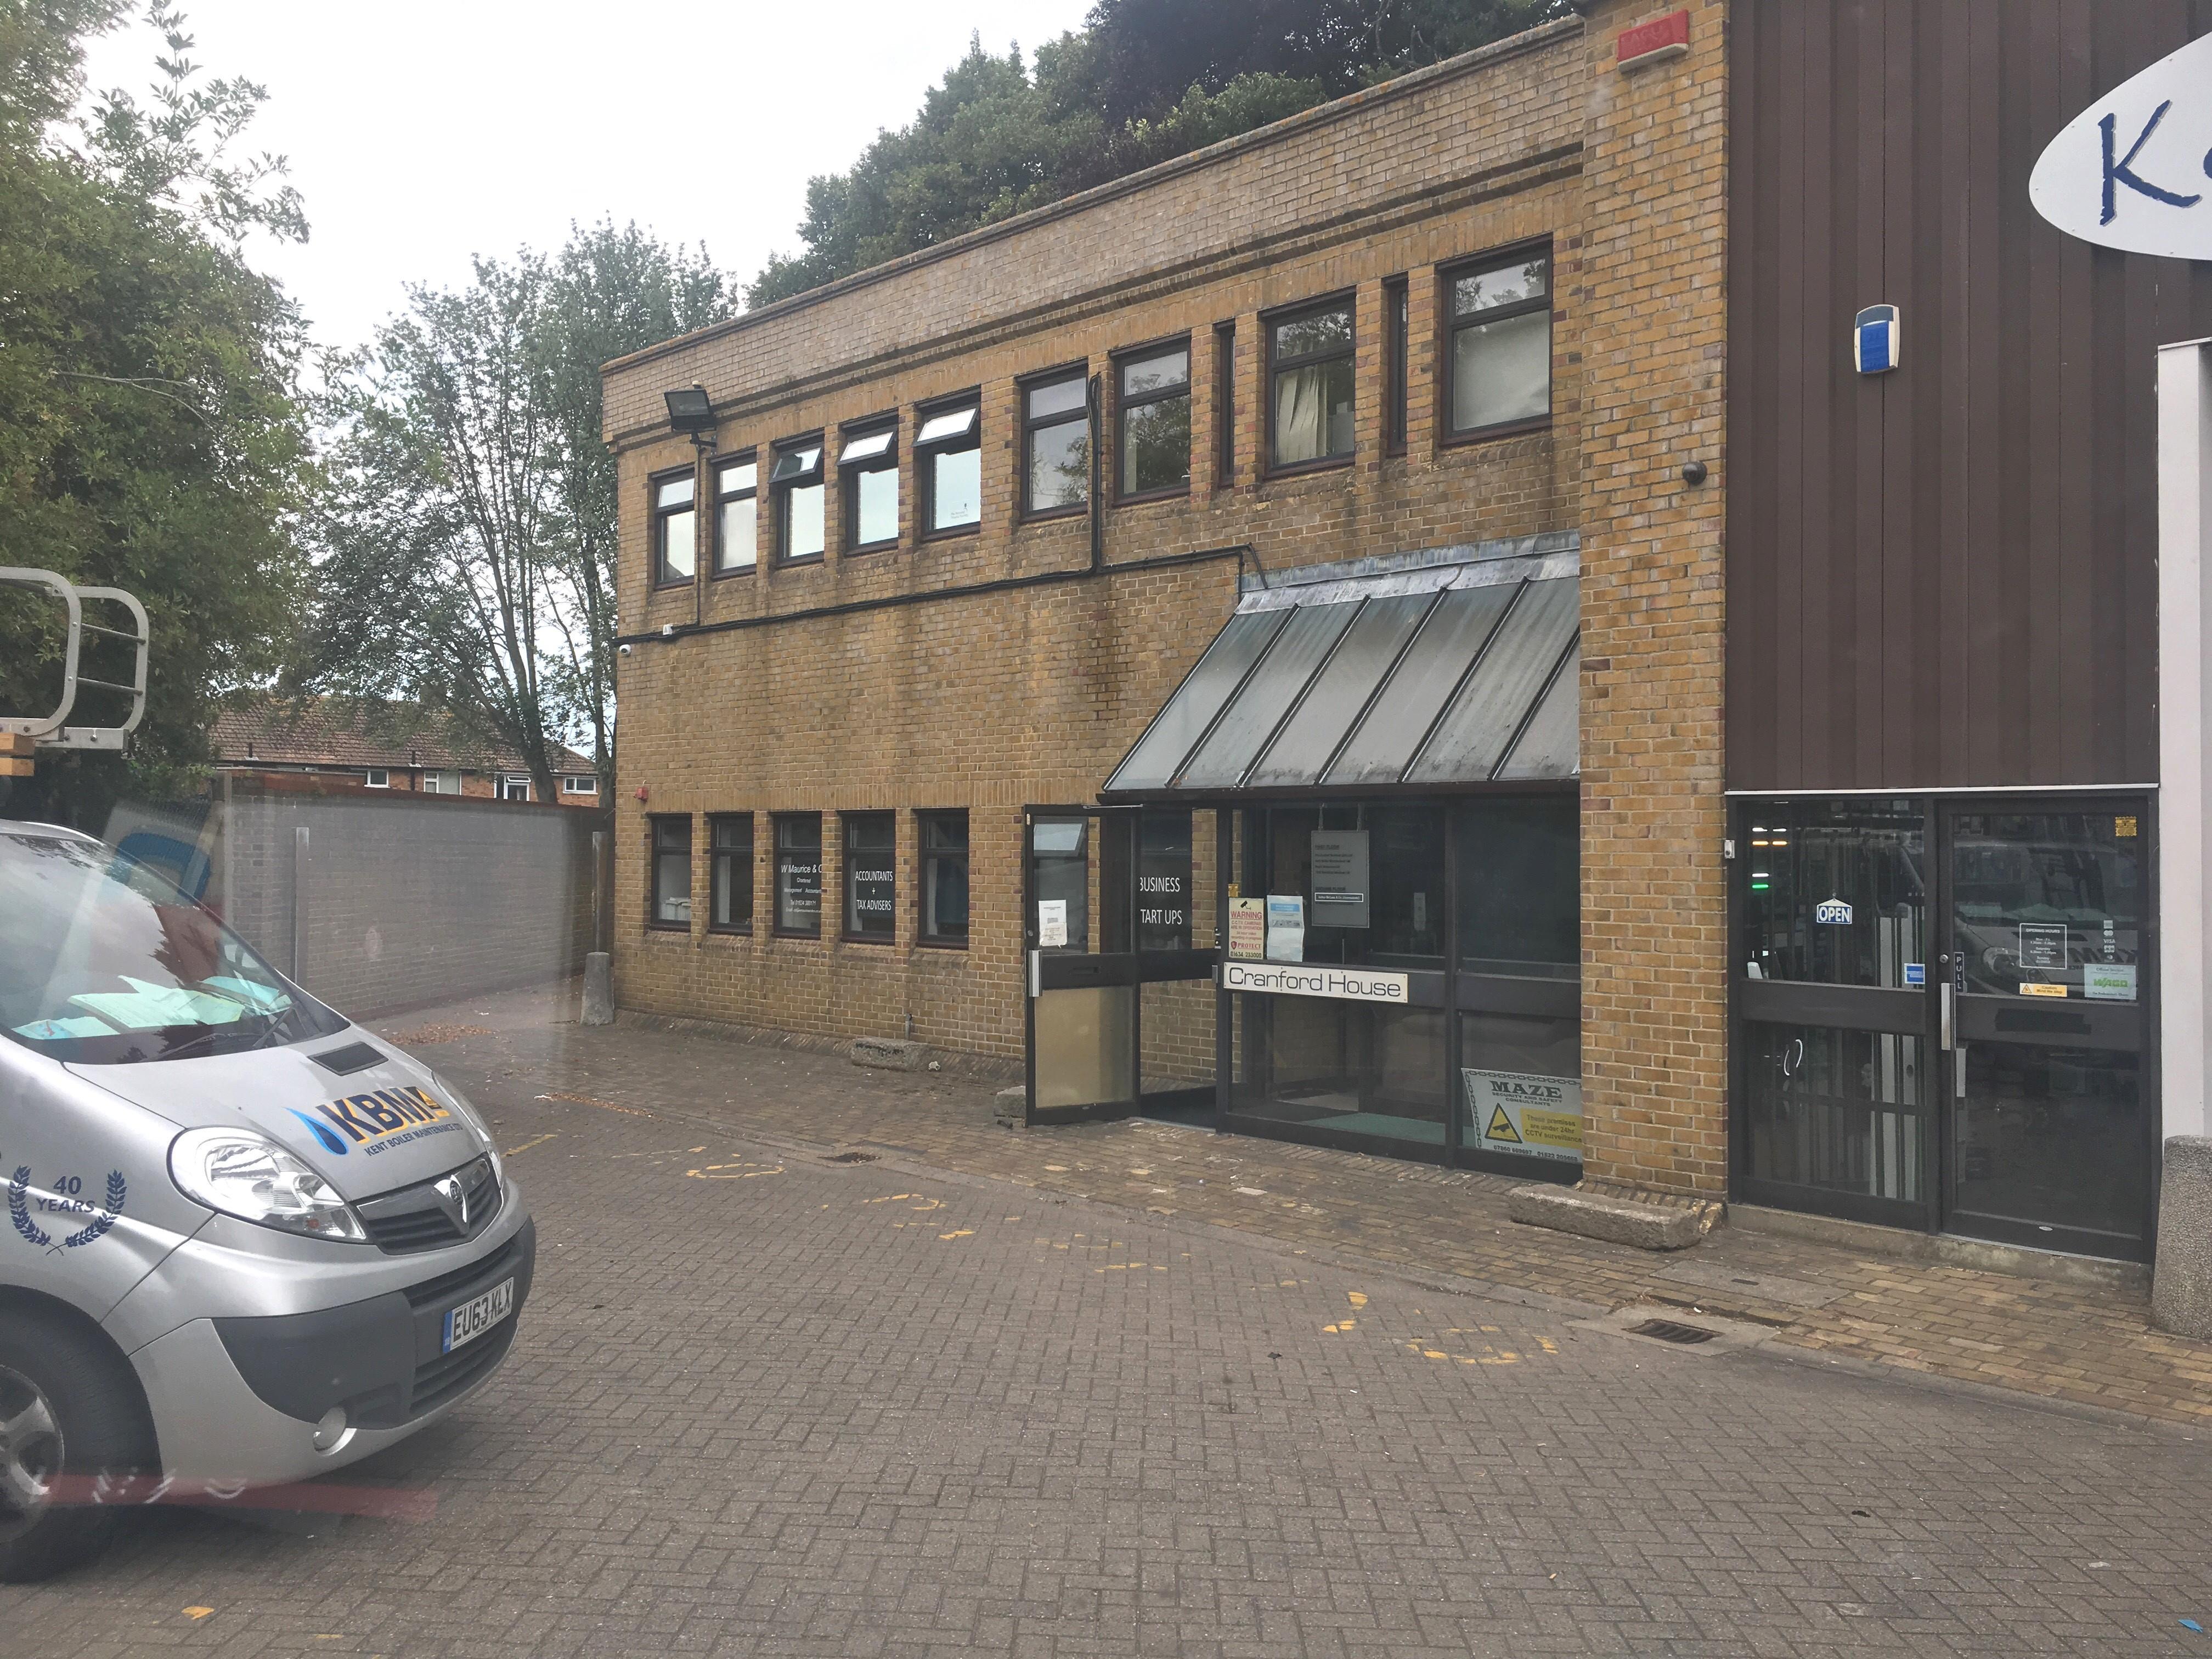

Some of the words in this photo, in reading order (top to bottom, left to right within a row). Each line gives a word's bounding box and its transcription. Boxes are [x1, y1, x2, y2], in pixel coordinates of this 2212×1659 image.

[788, 865, 811, 873] Maurice
[855, 871, 893, 882] ACCOUNTANTS
[1140, 877, 1180, 892] BUSINESS
[857, 900, 866, 910] TAX
[867, 900, 891, 911] ADVISERS
[1165, 910, 1182, 925] UPS
[1819, 906, 1850, 922] OPEN
[1229, 967, 1323, 991] Cranford
[1329, 974, 1401, 997] House
[1489, 1080, 1562, 1099] MAZE
[1505, 1097, 1551, 1107] CONSULTANTS
[1527, 1114, 1545, 1123] These
[1547, 1117, 1576, 1127] premises
[364, 1141, 388, 1156] KENT
[388, 1133, 416, 1148] BOILER
[414, 1125, 456, 1139] MAINTENANCE
[1525, 1129, 1543, 1137] CCTV
[1544, 1132, 1582, 1143] surveillance
[53, 1176, 82, 1195] 40
[36, 1198, 95, 1213] YEARS
[453, 1296, 489, 1342] EU63
[490, 1281, 512, 1321] KLX
